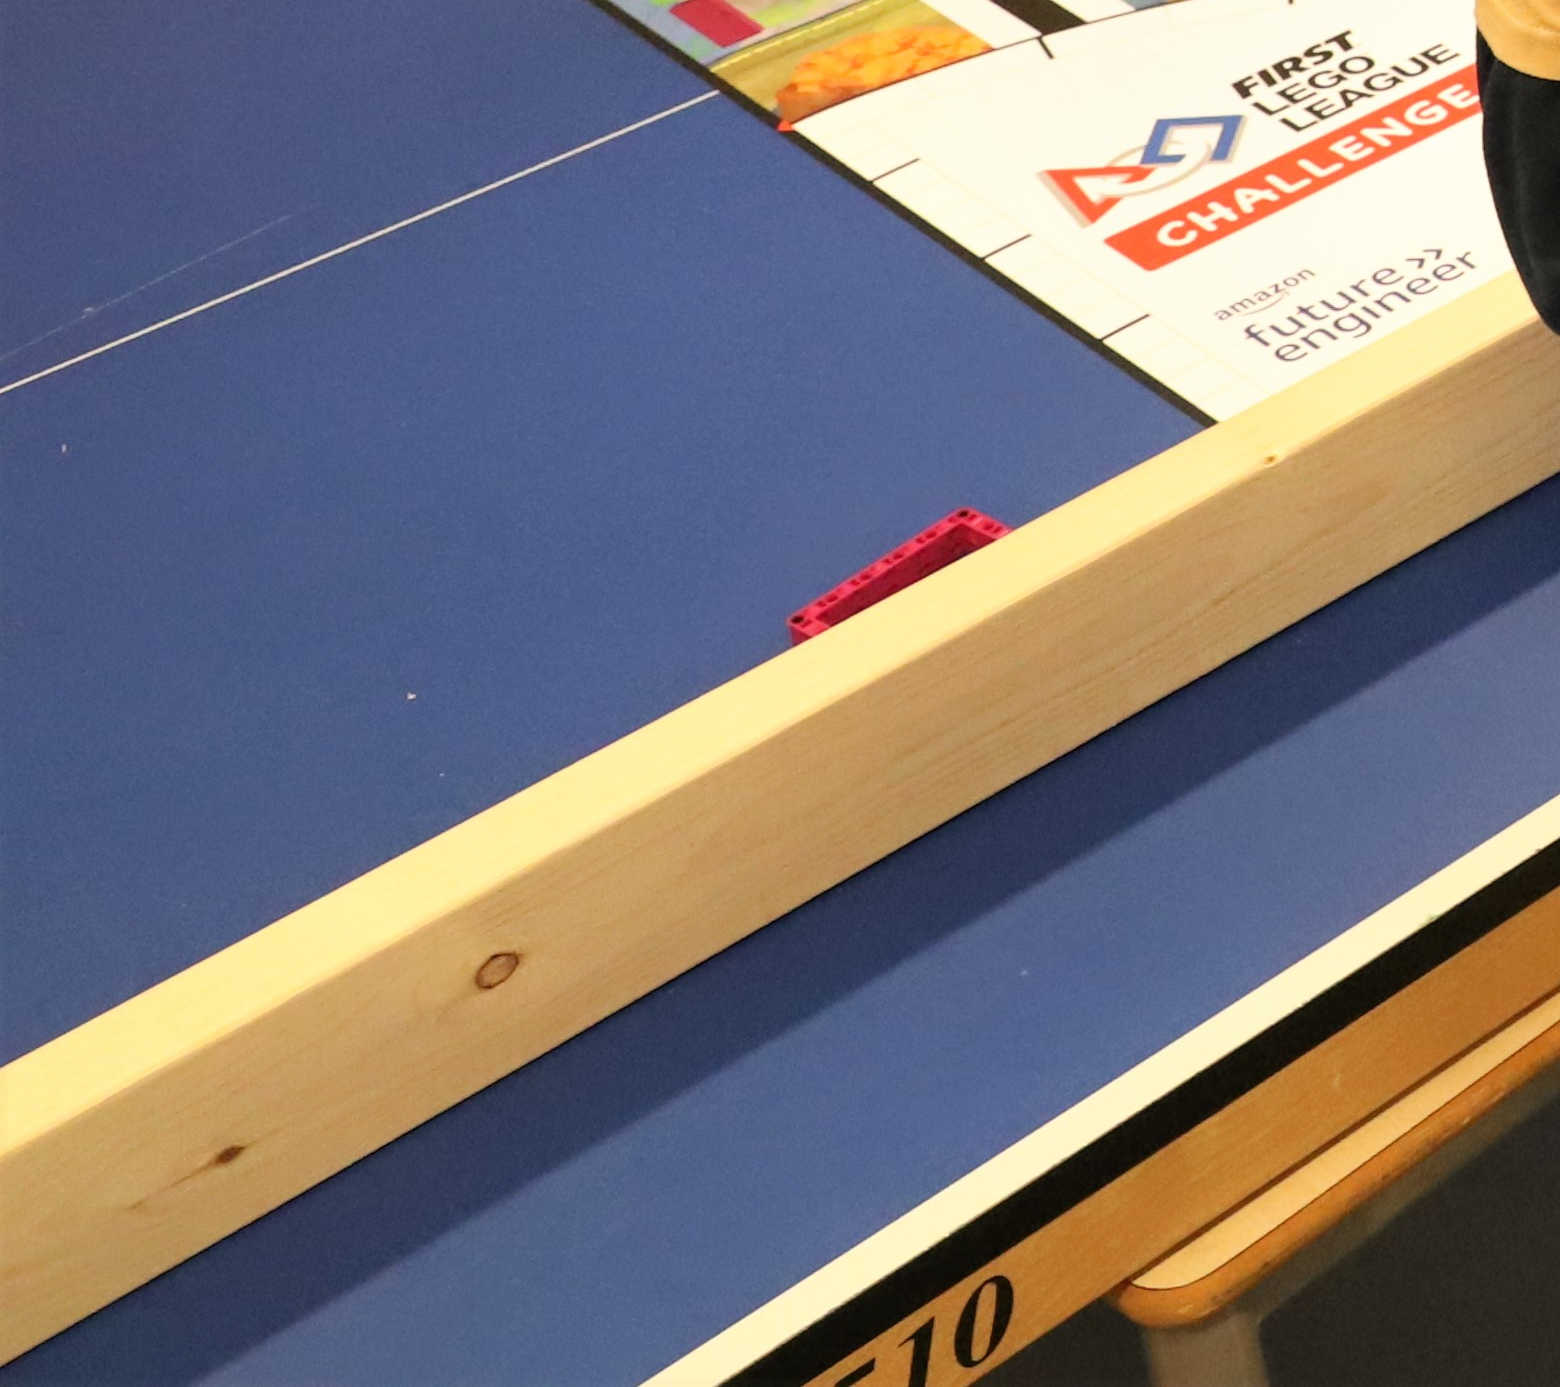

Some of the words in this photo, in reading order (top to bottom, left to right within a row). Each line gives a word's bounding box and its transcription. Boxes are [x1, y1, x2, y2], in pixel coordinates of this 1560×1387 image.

[1230, 30, 1354, 100] FIRST
[1250, 56, 1376, 117] LEGO
[1279, 43, 1462, 133] LEAGUE
[1155, 81, 1481, 248] CHALLENGE
[1213, 267, 1317, 323] amazon
[1243, 265, 1405, 349] future
[1273, 250, 1480, 364] engineer
[834, 1274, 1014, 1387] 10
